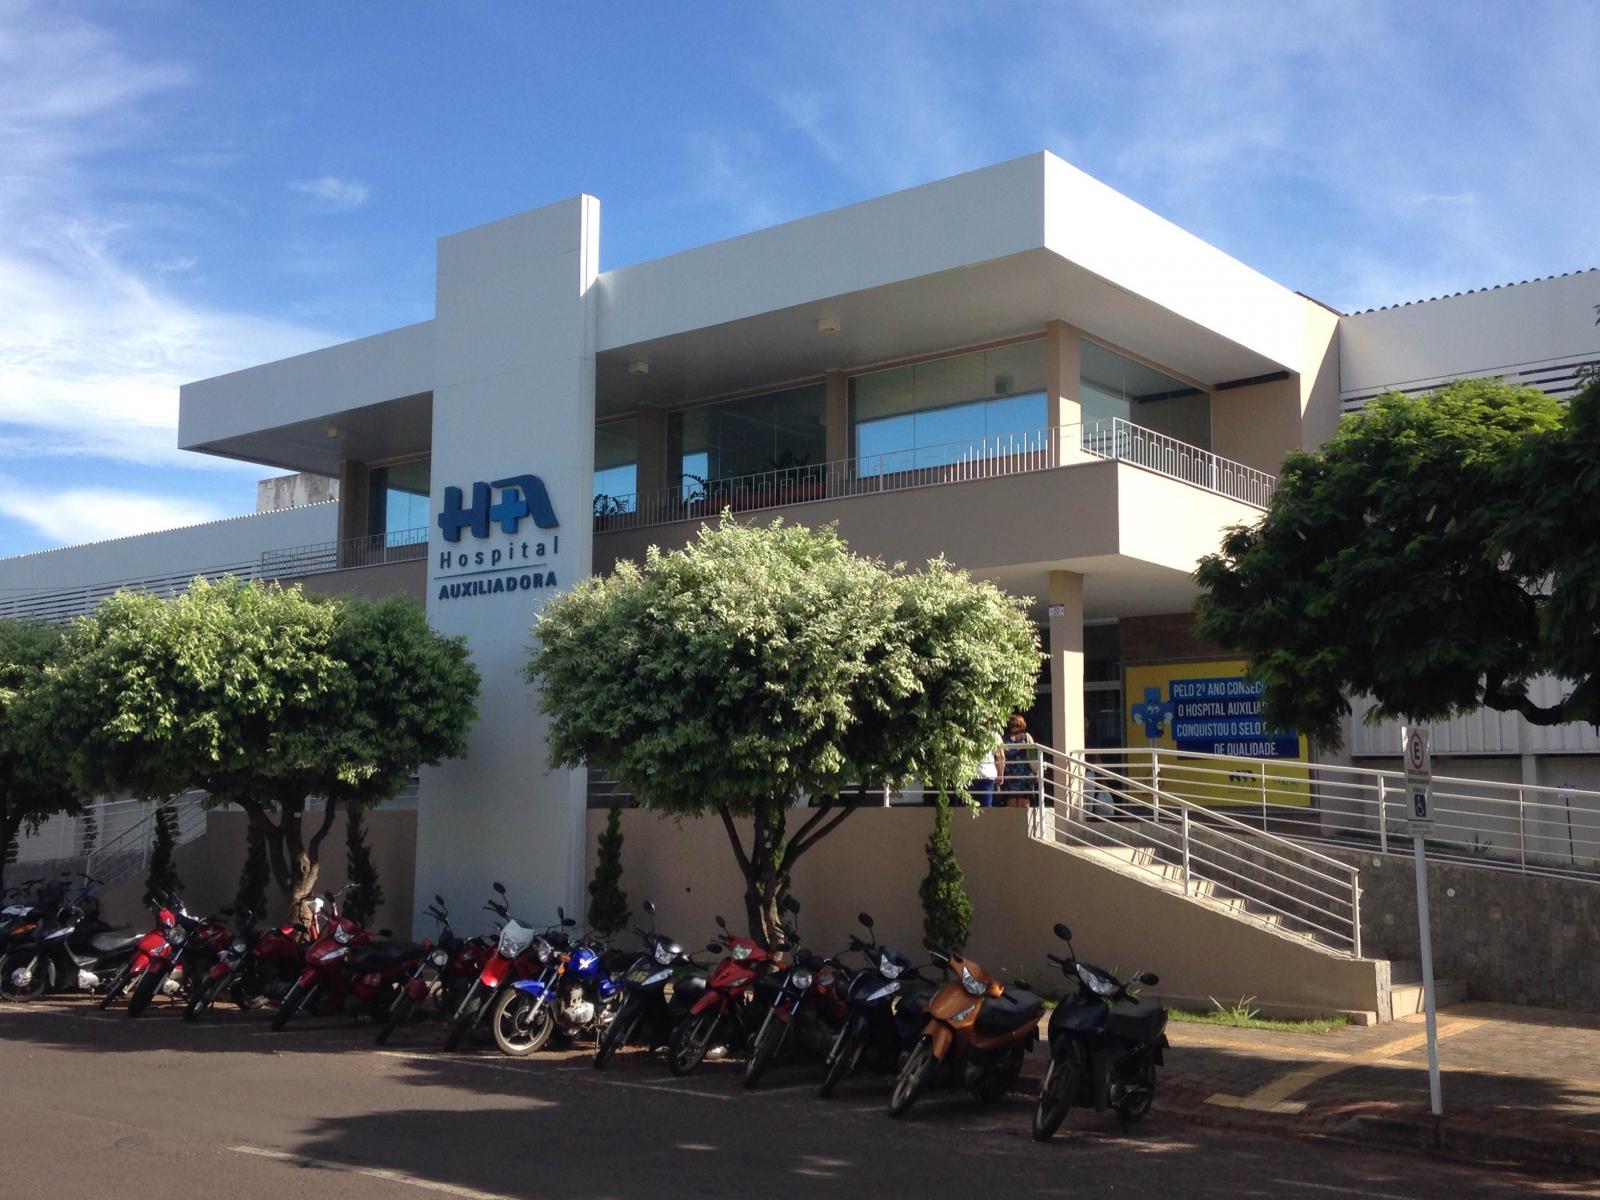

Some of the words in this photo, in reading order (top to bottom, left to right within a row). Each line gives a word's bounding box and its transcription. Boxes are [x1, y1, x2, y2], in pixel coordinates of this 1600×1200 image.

[440, 536, 558, 569] Hospital
[438, 571, 557, 600] AUXILIADORA
[1174, 684, 1195, 698] PELO
[1208, 682, 1225, 696] ANO
[1178, 704, 1184, 717] O
[1186, 702, 1226, 717] HOSPITAL
[1177, 722, 1229, 737] CONQUISTOU
[1231, 723, 1237, 736] O
[1239, 722, 1261, 735] SELO
[1214, 743, 1224, 755] DE
[1227, 742, 1279, 757] QUALIDADE.
[1414, 742, 1420, 760] E
